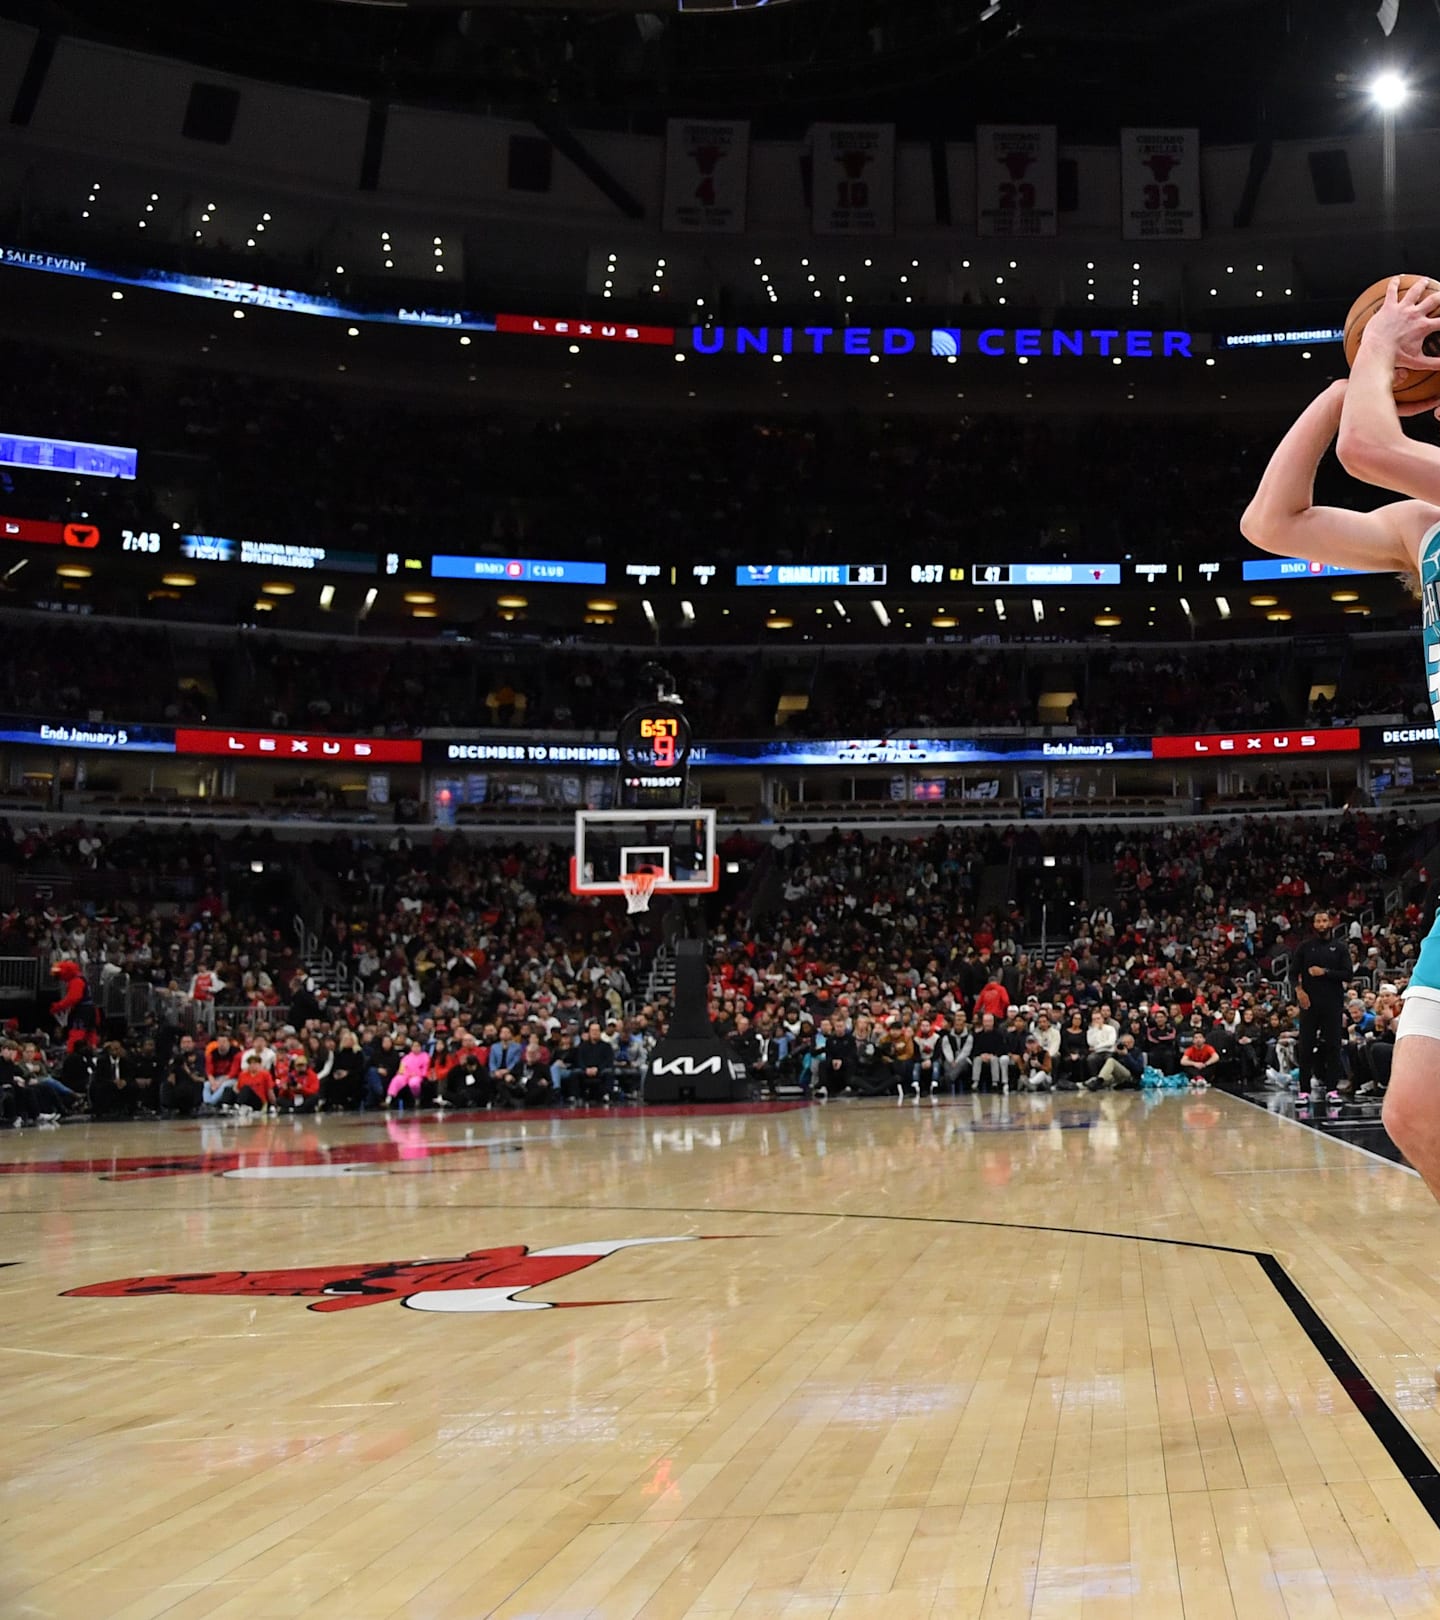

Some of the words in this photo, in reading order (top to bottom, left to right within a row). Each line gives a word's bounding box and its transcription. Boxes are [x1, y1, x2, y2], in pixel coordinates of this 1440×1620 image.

[999, 183, 1036, 209] 23
[1143, 184, 1180, 210] 33
[6, 249, 44, 266] SALES
[46, 256, 87, 272] EVENT
[532, 319, 640, 339] LEXUS
[1226, 333, 1272, 345] DECEMBER
[1273, 332, 1285, 342] TO
[1286, 330, 1332, 341] REMEMBER
[692, 326, 917, 355] UNITED
[976, 328, 1193, 358] CENTER
[121, 529, 161, 553] 7:43
[532, 565, 565, 578] CLUB
[1280, 563, 1307, 574] BMO
[40, 724, 69, 741] Ends
[69, 727, 117, 746] January
[117, 729, 128, 744] 5
[640, 718, 678, 738] 6:57
[1382, 727, 1439, 743] DECEMBE
[228, 737, 372, 756] LEXUS
[448, 744, 525, 760] DECEMBER
[528, 746, 547, 760] TO
[1043, 742, 1067, 755] Ends
[1067, 742, 1104, 756] January
[1105, 741, 1114, 754] 5
[1194, 735, 1316, 752] LEXUS
[652, 1055, 722, 1076] KIA
